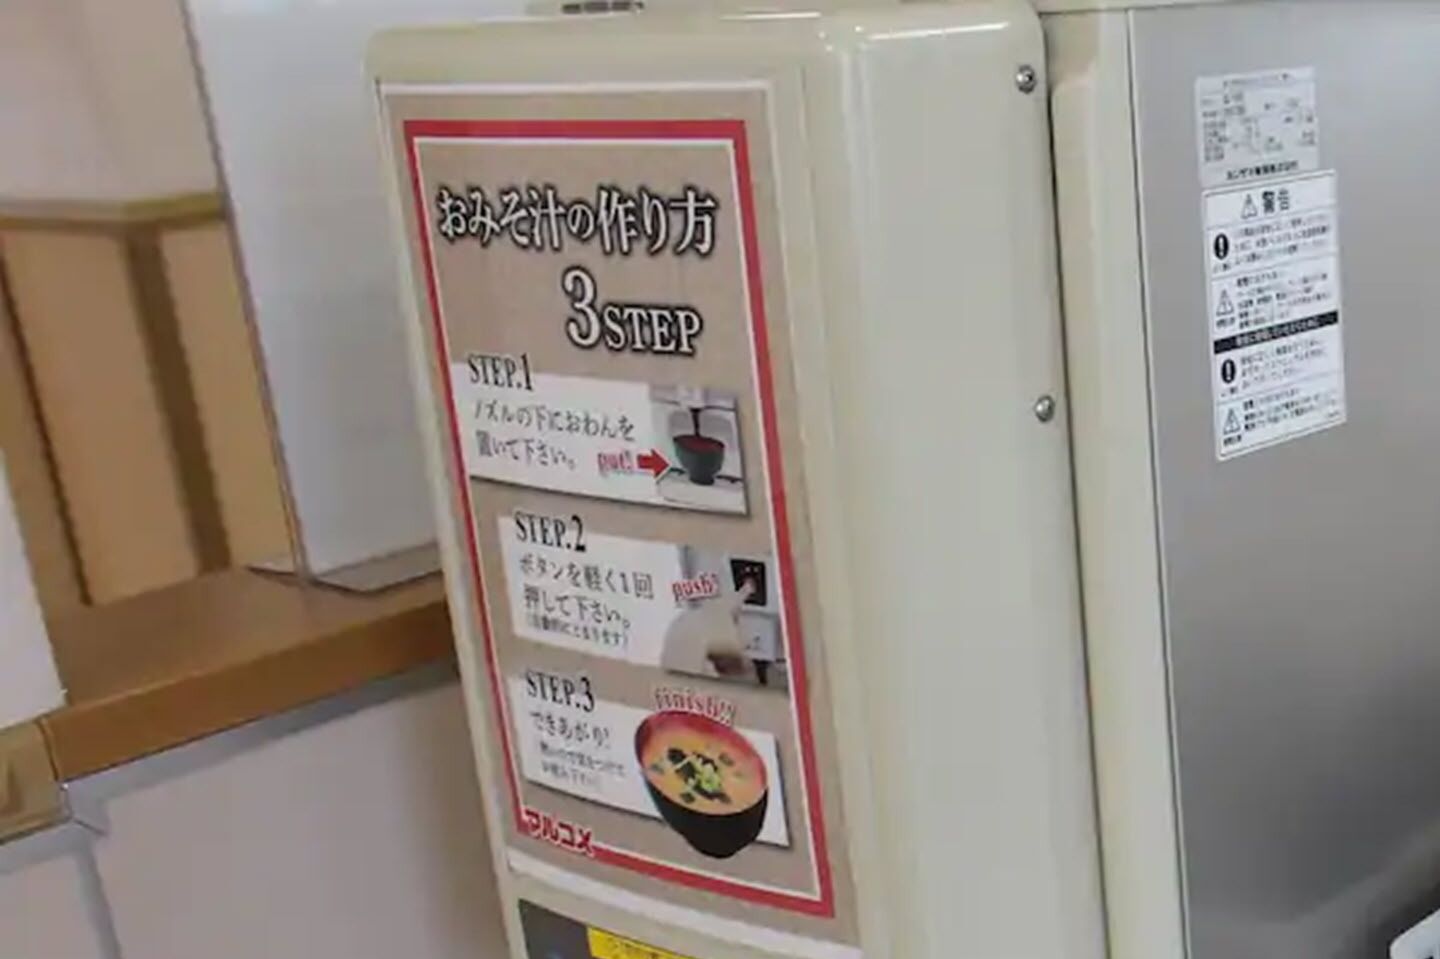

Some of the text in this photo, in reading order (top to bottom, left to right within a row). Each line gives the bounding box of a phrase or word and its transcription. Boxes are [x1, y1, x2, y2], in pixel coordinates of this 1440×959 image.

[437, 184, 717, 257] おみそ汁の作り方
[468, 354, 533, 391] STEP.1
[475, 400, 635, 441] ノズルの下におわんを
[514, 511, 586, 552] STEP.2
[520, 553, 654, 599] ボタンを軽く1回
[524, 582, 631, 628] 押して下さい。
[526, 671, 595, 713] STEP.3
[524, 808, 594, 855] マルコメ
